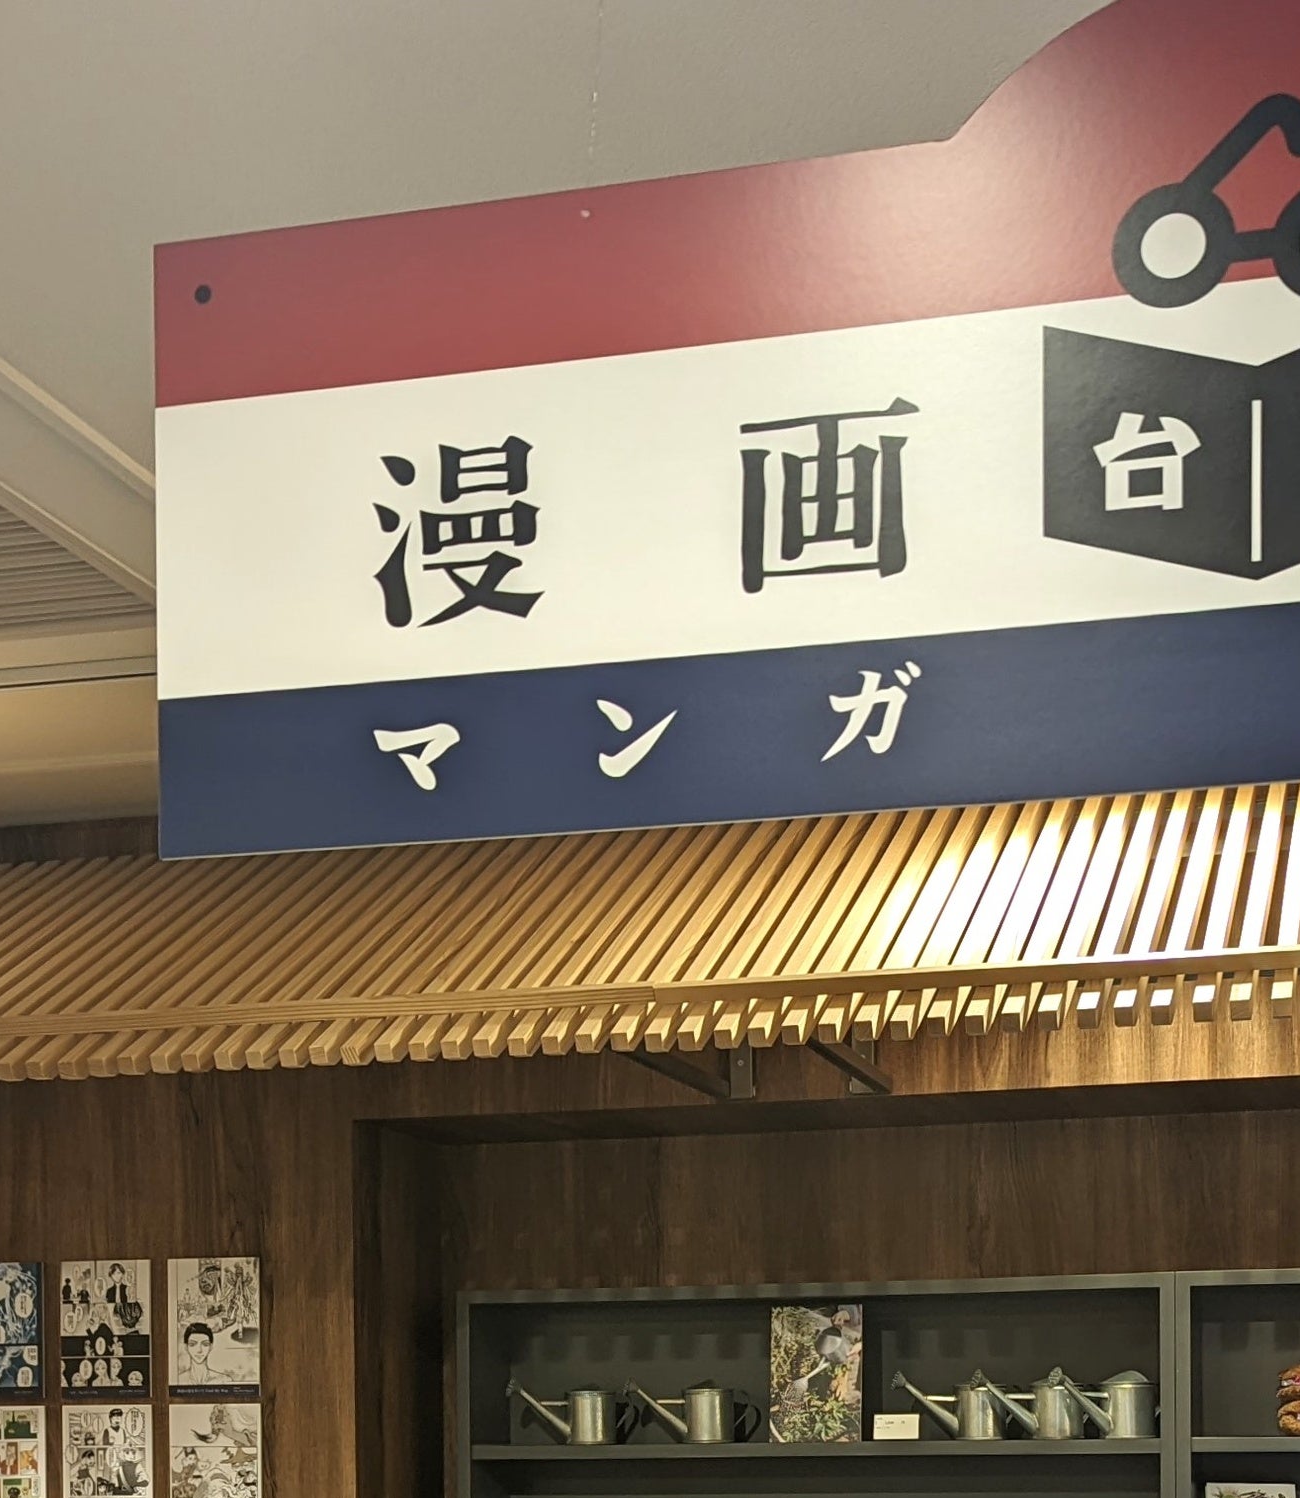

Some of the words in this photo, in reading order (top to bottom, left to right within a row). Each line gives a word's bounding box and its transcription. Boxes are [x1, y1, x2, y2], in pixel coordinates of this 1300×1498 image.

[373, 397, 919, 628] 漫画
[373, 660, 923, 790] マンガ
